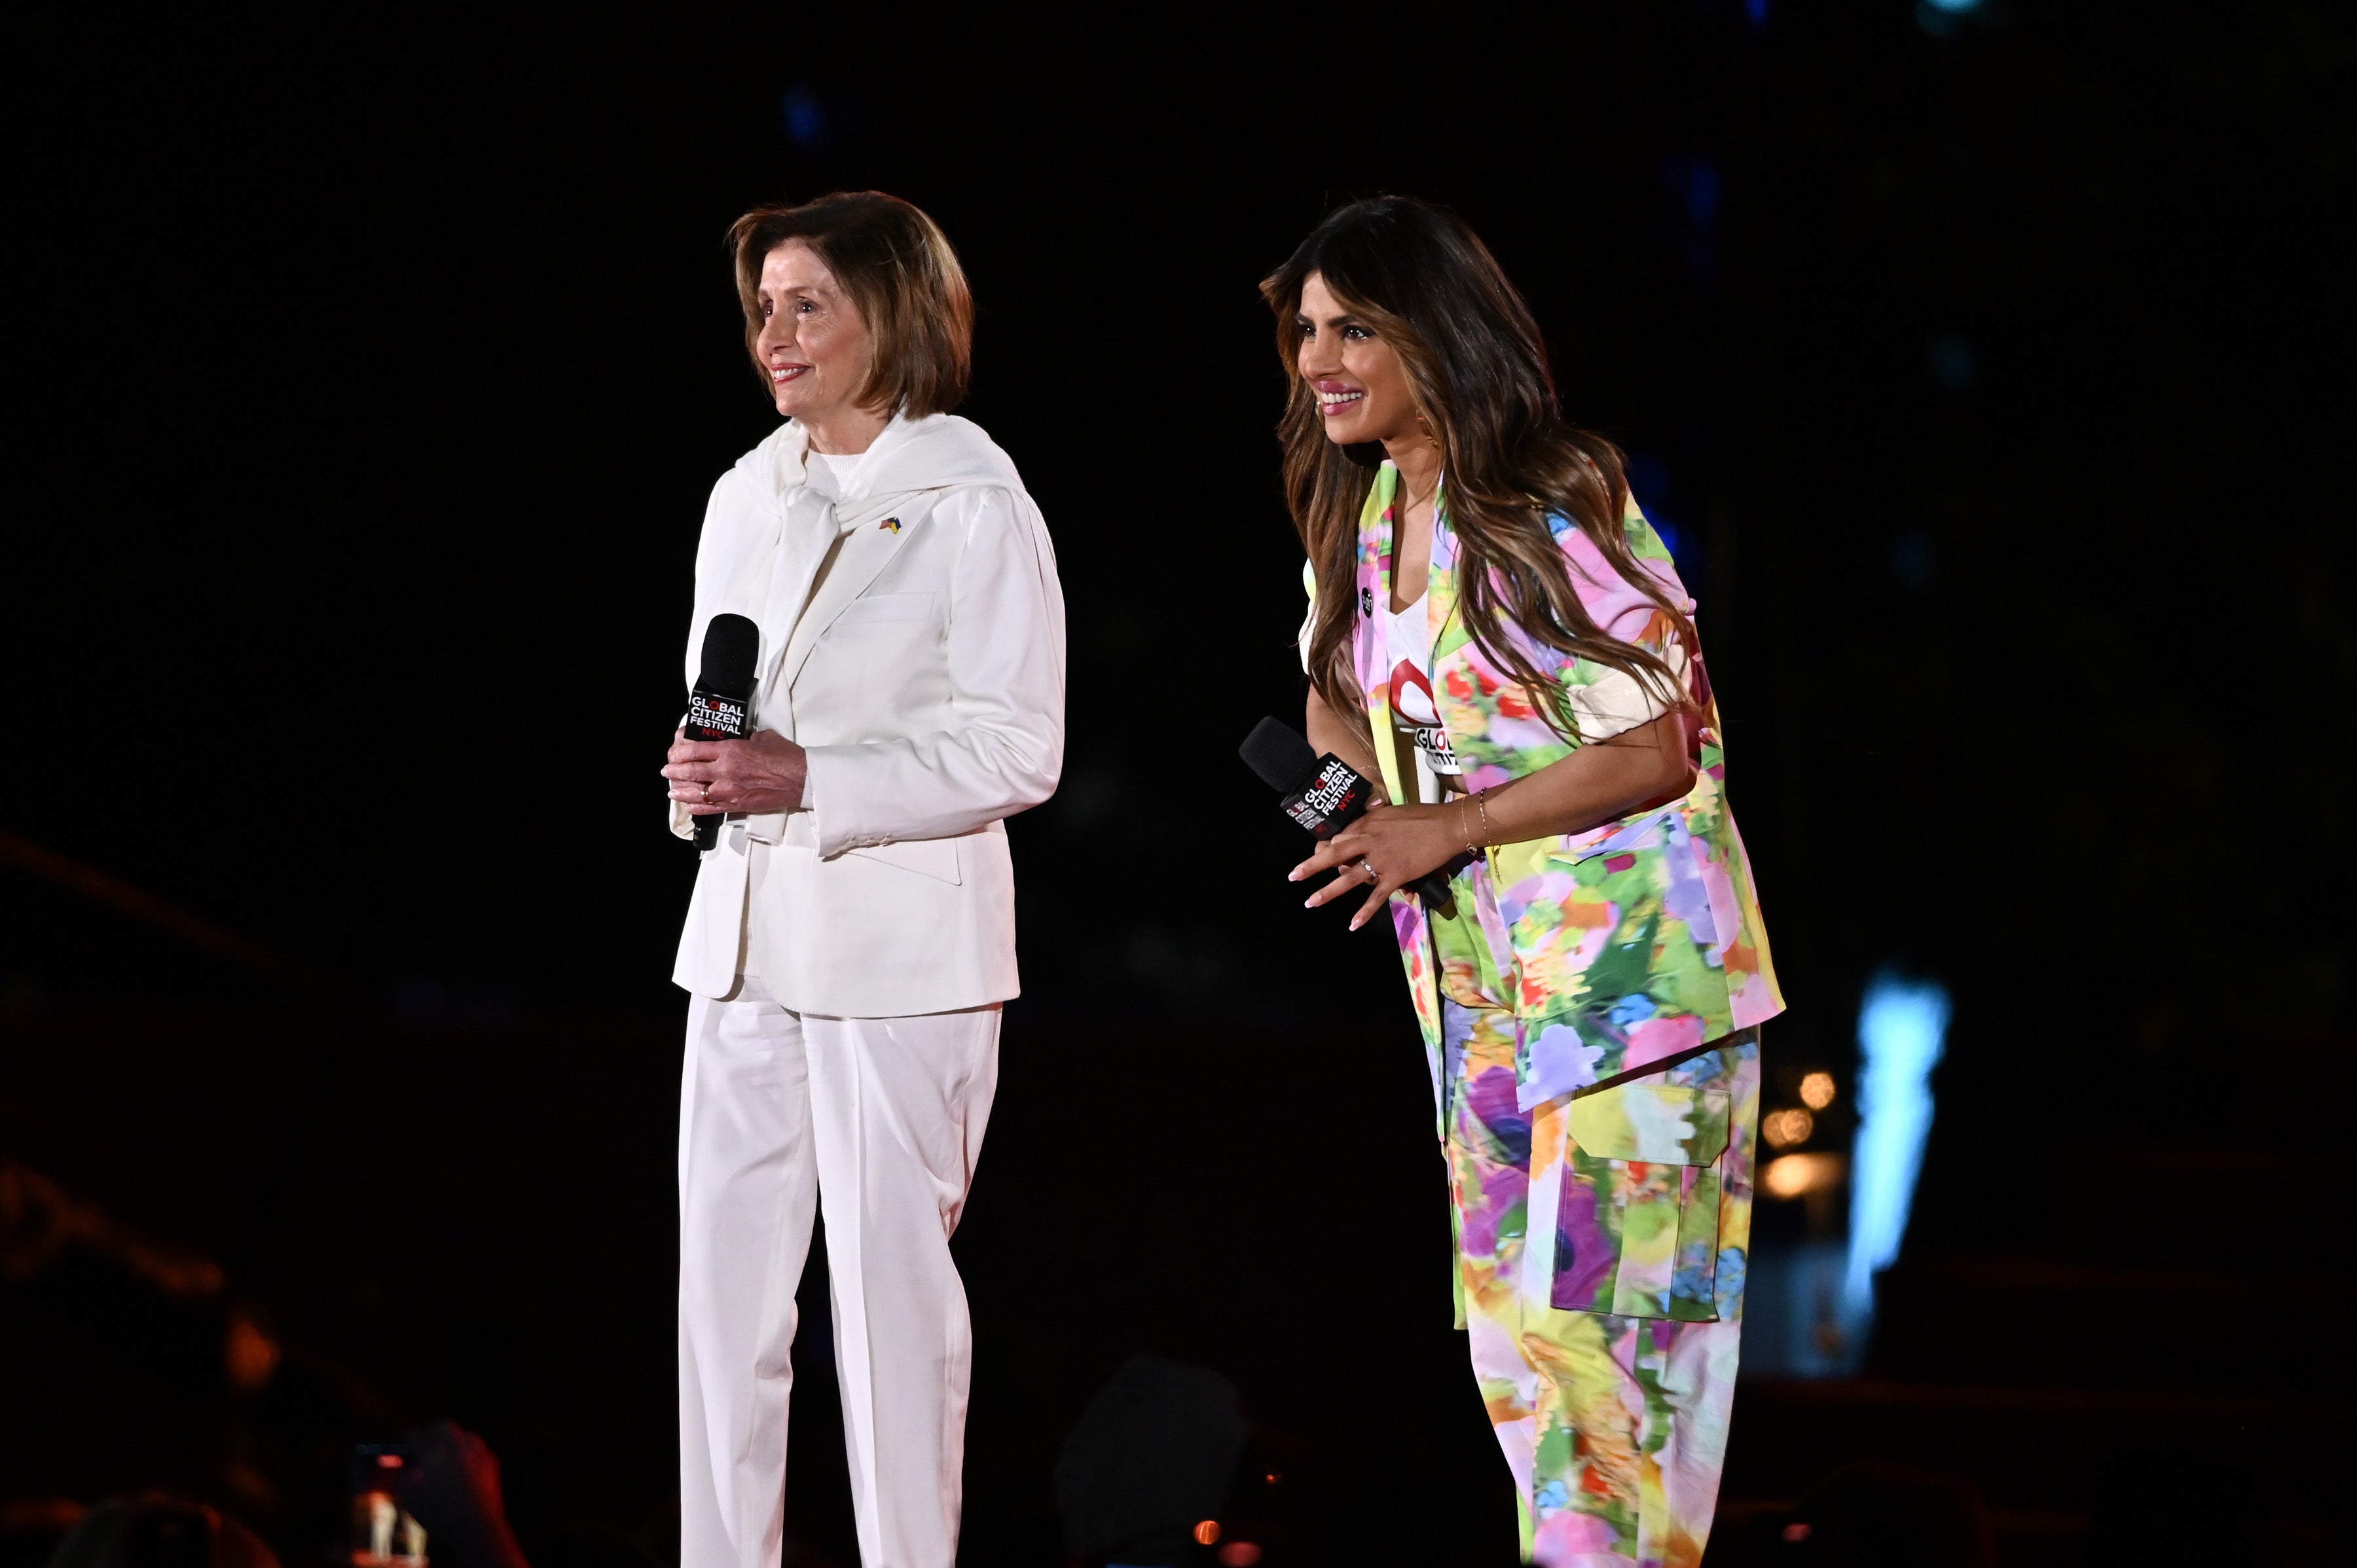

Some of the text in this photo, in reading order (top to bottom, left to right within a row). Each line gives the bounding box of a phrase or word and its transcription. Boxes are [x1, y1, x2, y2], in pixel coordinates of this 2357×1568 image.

[691, 697, 744, 717] GLOBAL
[691, 706, 740, 725] CITIZEN
[690, 716, 741, 735] FESTIVAL
[702, 727, 725, 739] NYC
[1305, 760, 1342, 803] GLOBAL
[1313, 766, 1348, 810] CITIZEN
[1322, 774, 1357, 816] FESTIVAL
[1337, 790, 1356, 812] NYC
